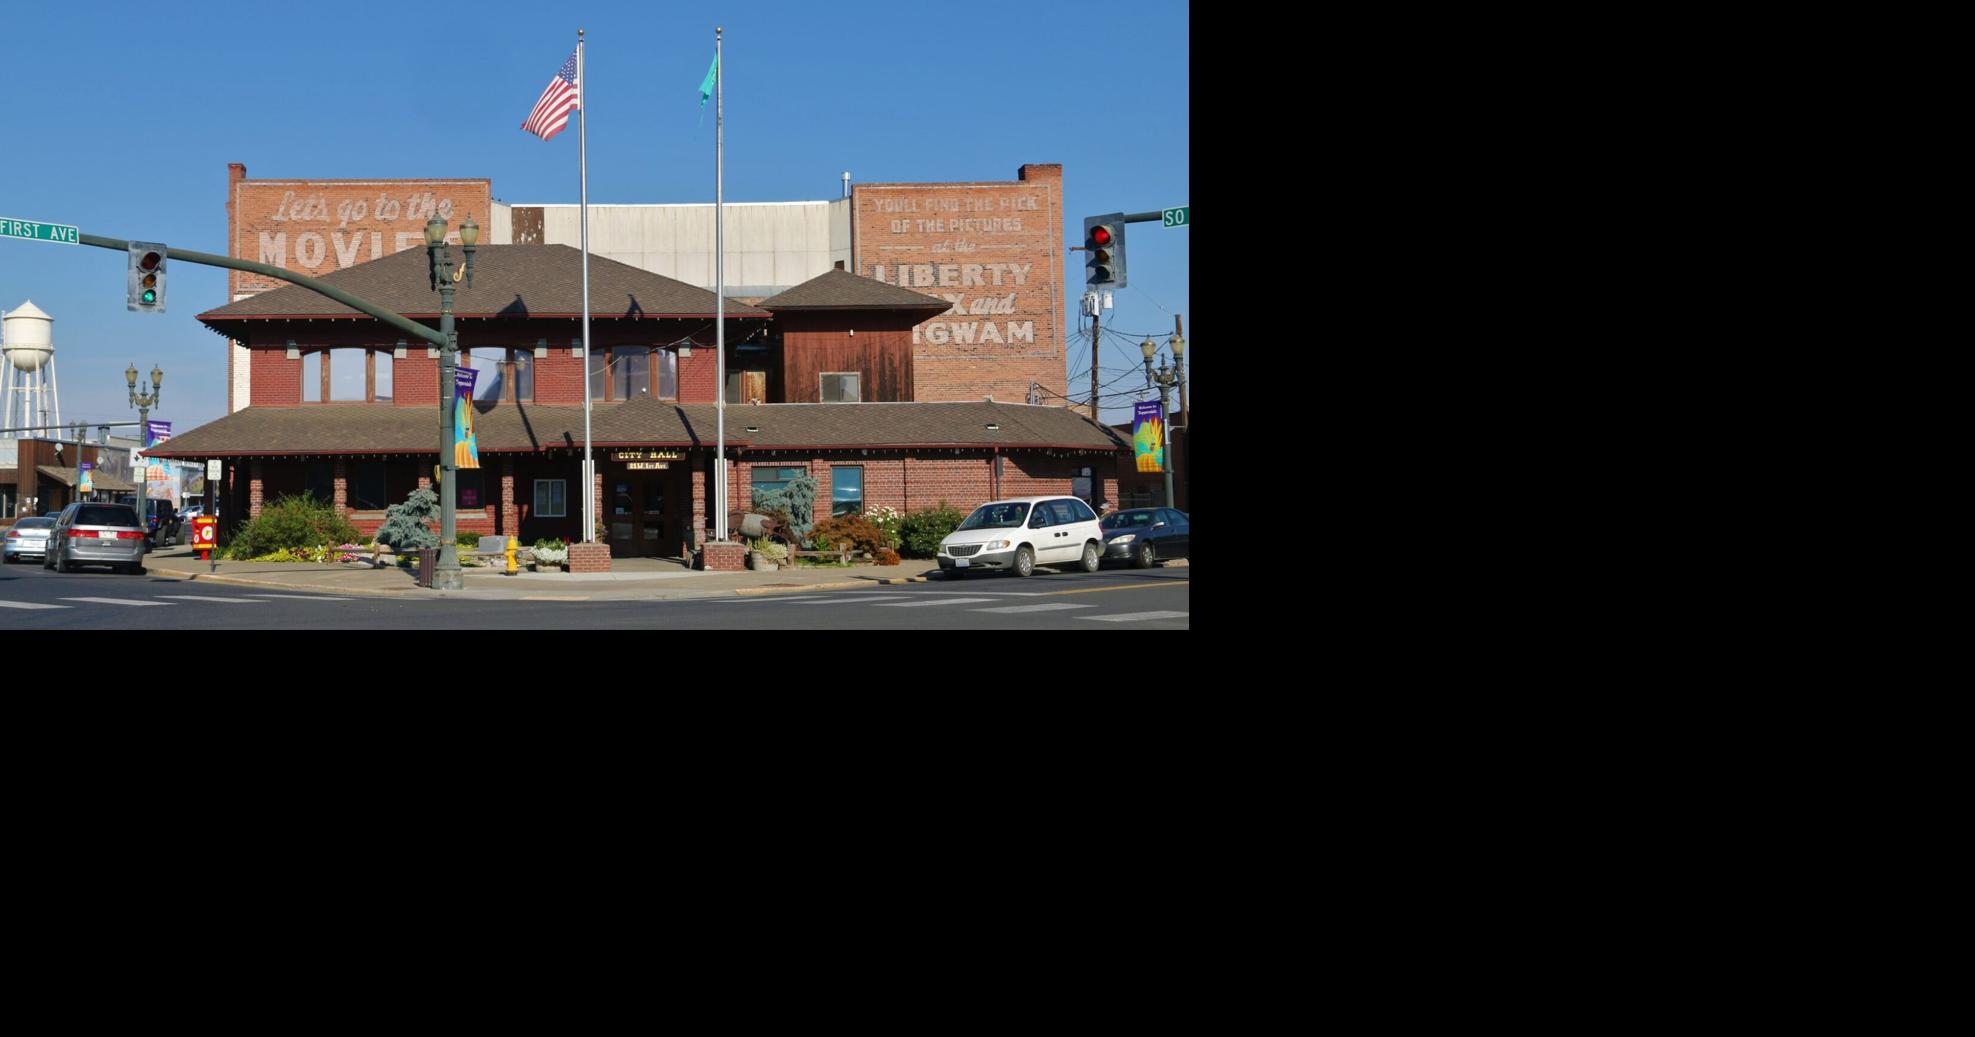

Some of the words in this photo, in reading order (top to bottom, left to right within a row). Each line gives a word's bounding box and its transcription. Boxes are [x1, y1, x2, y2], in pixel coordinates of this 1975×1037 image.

[337, 199, 368, 233] go
[375, 193, 400, 221] to
[407, 192, 455, 221] the
[925, 198, 960, 212] FIND
[965, 197, 994, 211] THE
[1000, 196, 1040, 211] PICK
[890, 219, 911, 234] OF
[916, 219, 945, 232] THE
[949, 217, 1022, 232] PICTURES
[1165, 209, 1184, 226] SO
[0, 220, 40, 238] FIRST
[50, 226, 76, 242] AVE
[258, 231, 462, 269] MOVI
[873, 263, 1033, 288] LIBERTY
[970, 292, 1017, 315] and
